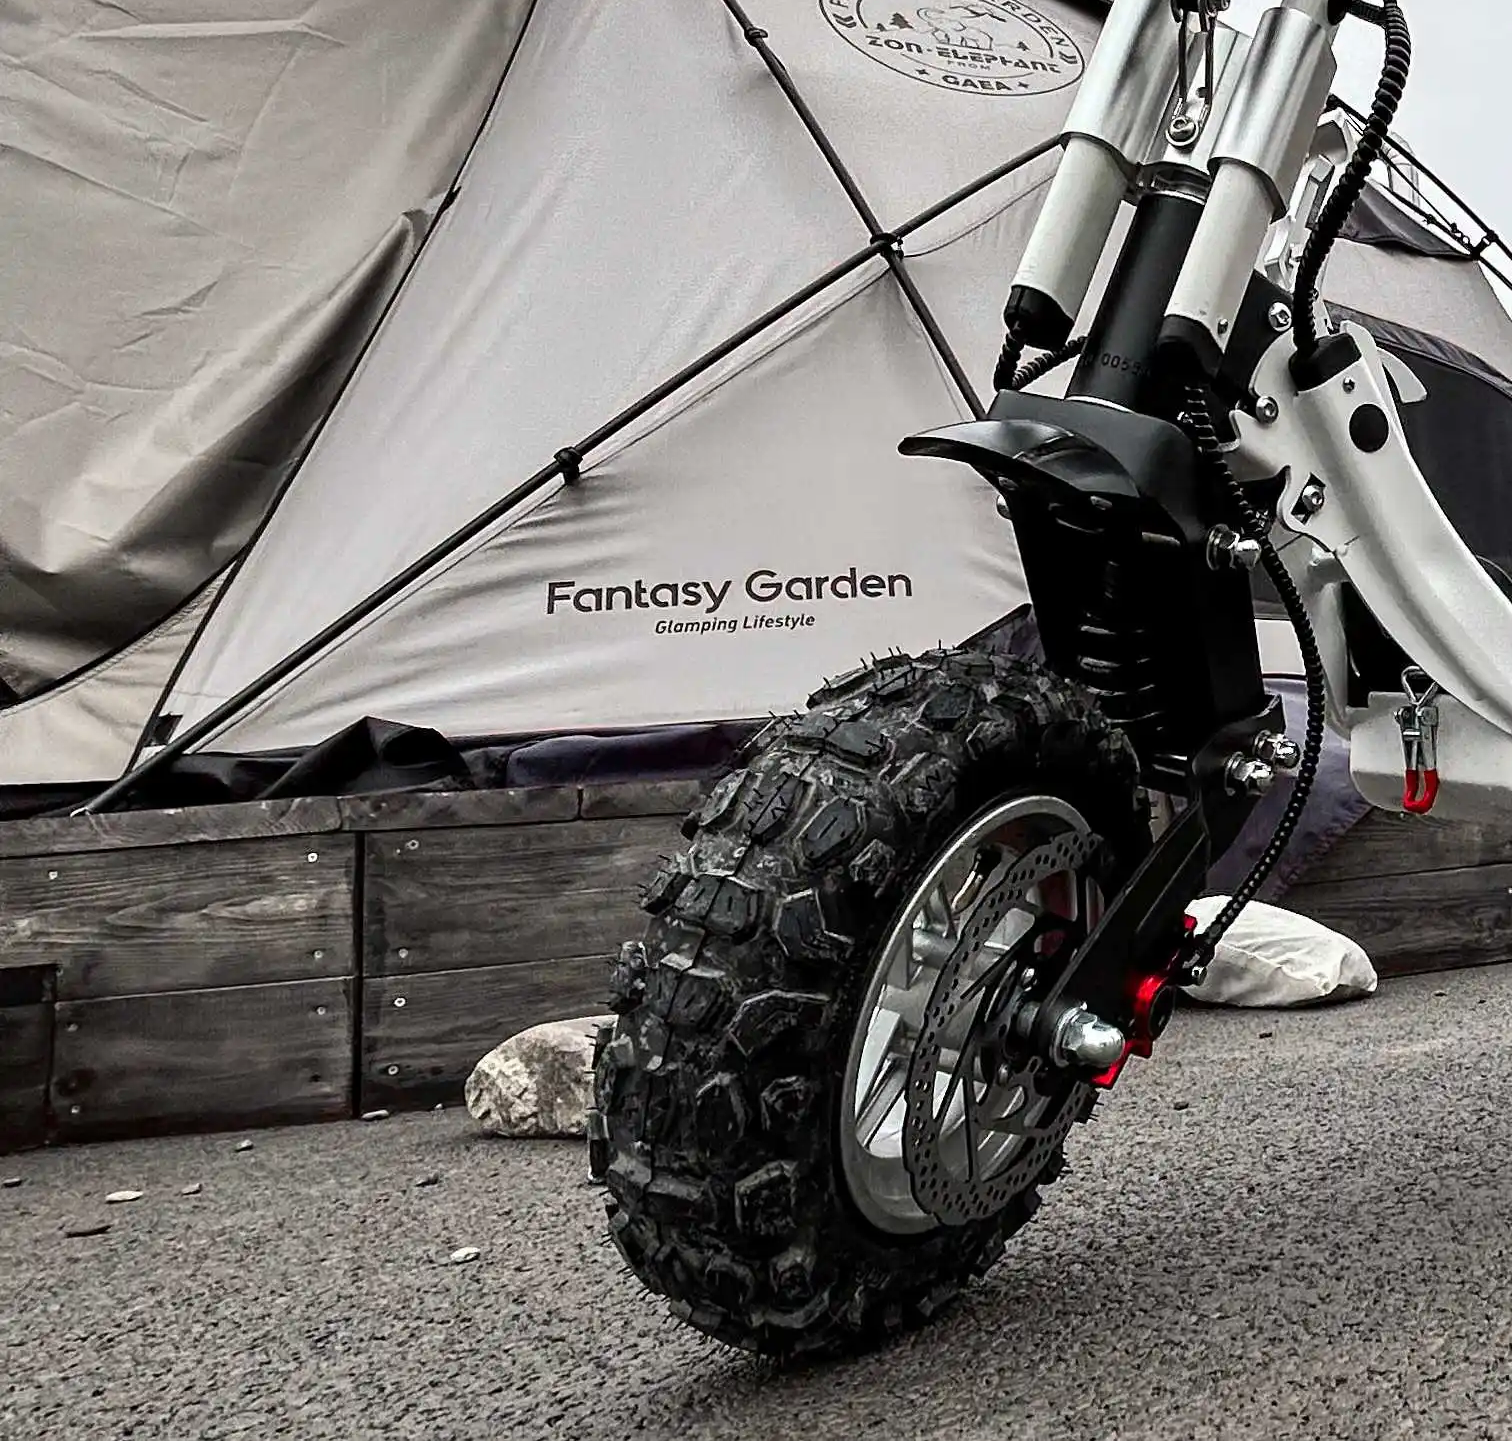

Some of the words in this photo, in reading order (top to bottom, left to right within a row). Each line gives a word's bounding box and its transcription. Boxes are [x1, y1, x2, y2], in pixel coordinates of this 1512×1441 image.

[941, 74, 1012, 91] GAEA
[546, 579, 732, 615] Fantasy
[745, 567, 913, 602] Garden
[655, 616, 737, 634] Glamping
[743, 613, 815, 629] Lifestyle
